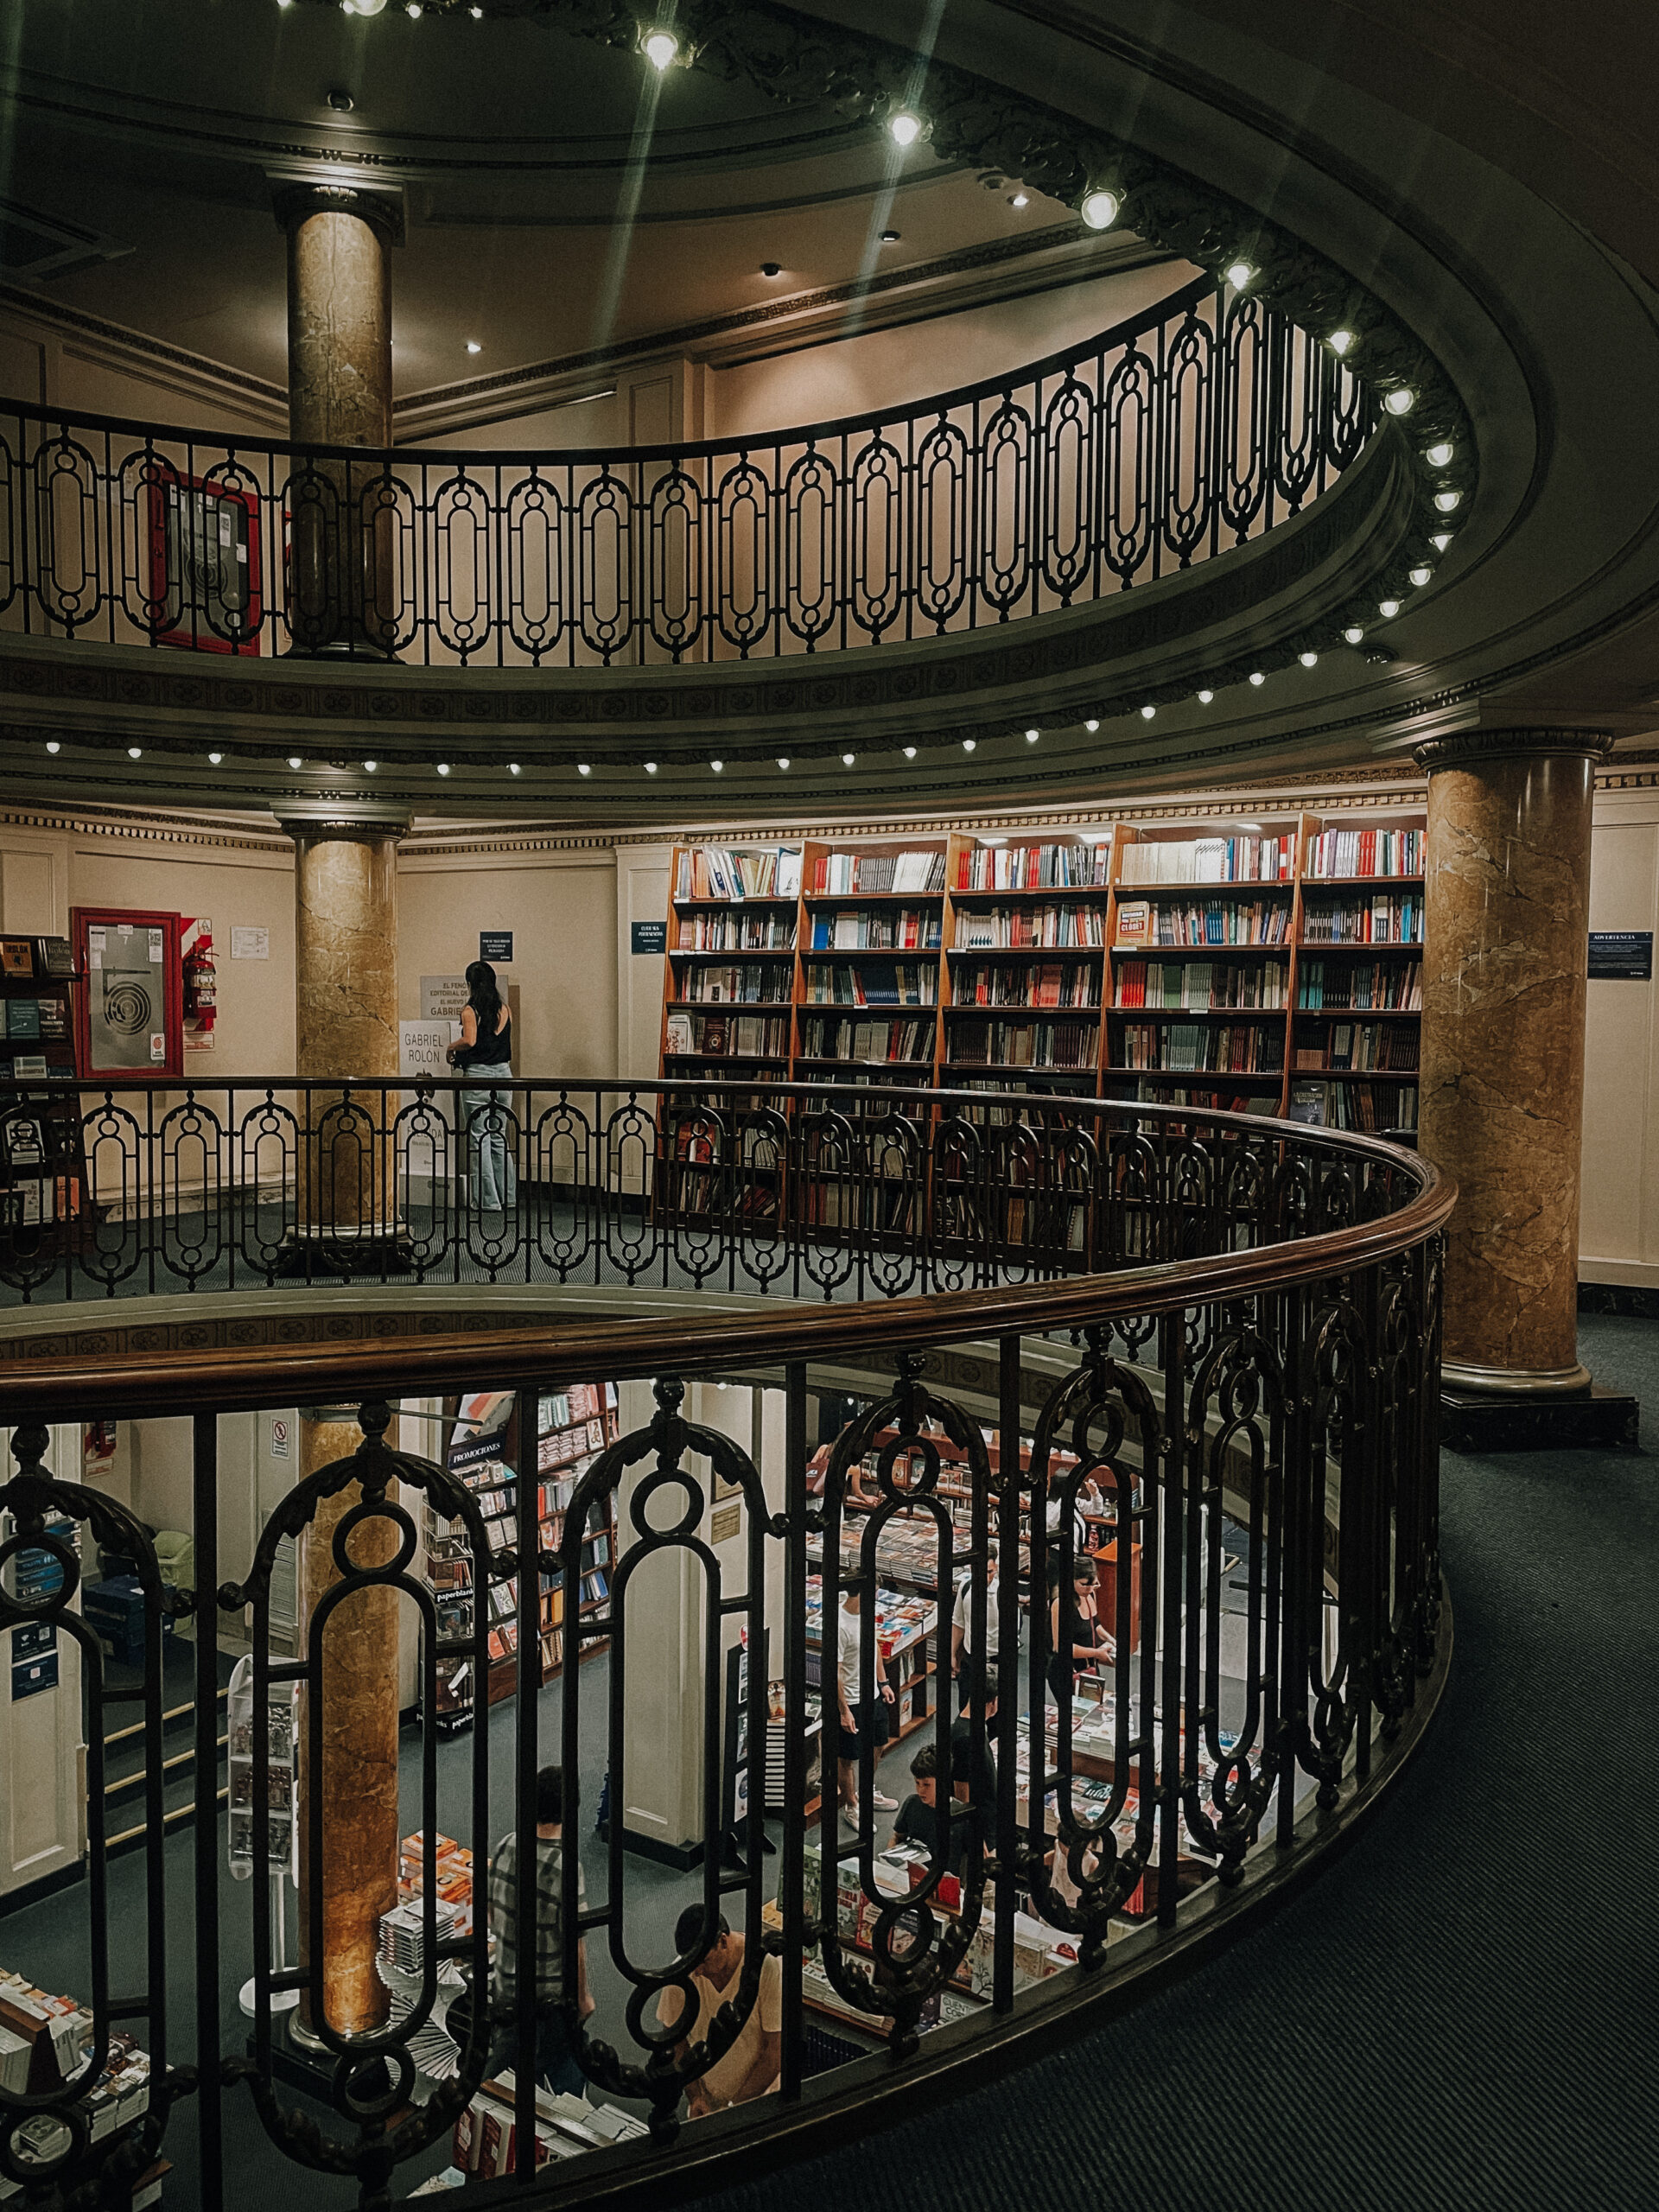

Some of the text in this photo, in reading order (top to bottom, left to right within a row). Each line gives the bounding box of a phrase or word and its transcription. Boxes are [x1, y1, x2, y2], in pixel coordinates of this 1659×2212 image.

[123, 935, 129, 945] 7
[430, 1007, 463, 1016] GABRIE
[405, 1033, 443, 1047] GABRIEL
[409, 1047, 440, 1063] ROLÓN
[453, 1443, 501, 1464] PROMOCIONES
[437, 1587, 474, 1603] paperblank
